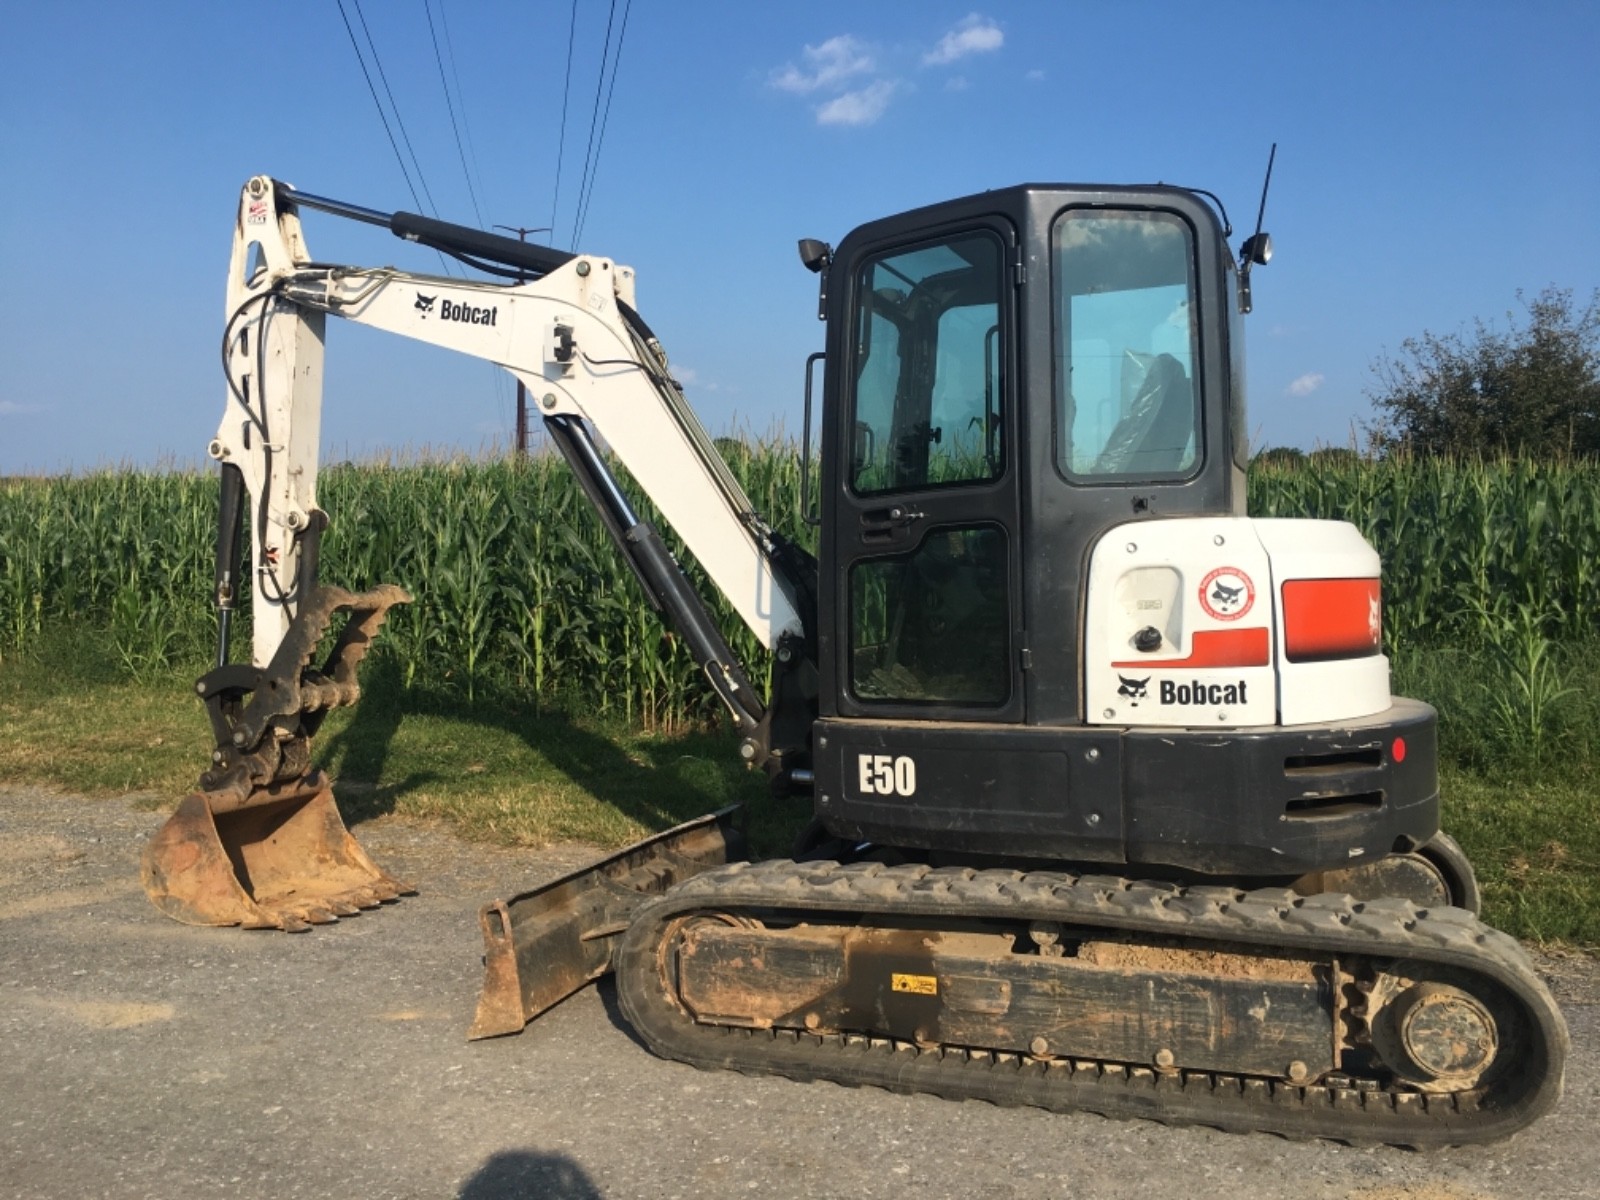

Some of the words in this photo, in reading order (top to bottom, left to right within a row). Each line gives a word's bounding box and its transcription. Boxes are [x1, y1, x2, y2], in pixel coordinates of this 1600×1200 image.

[441, 299, 497, 326] Bobcat
[1160, 680, 1247, 705] Bobcat
[858, 754, 916, 796] E50
